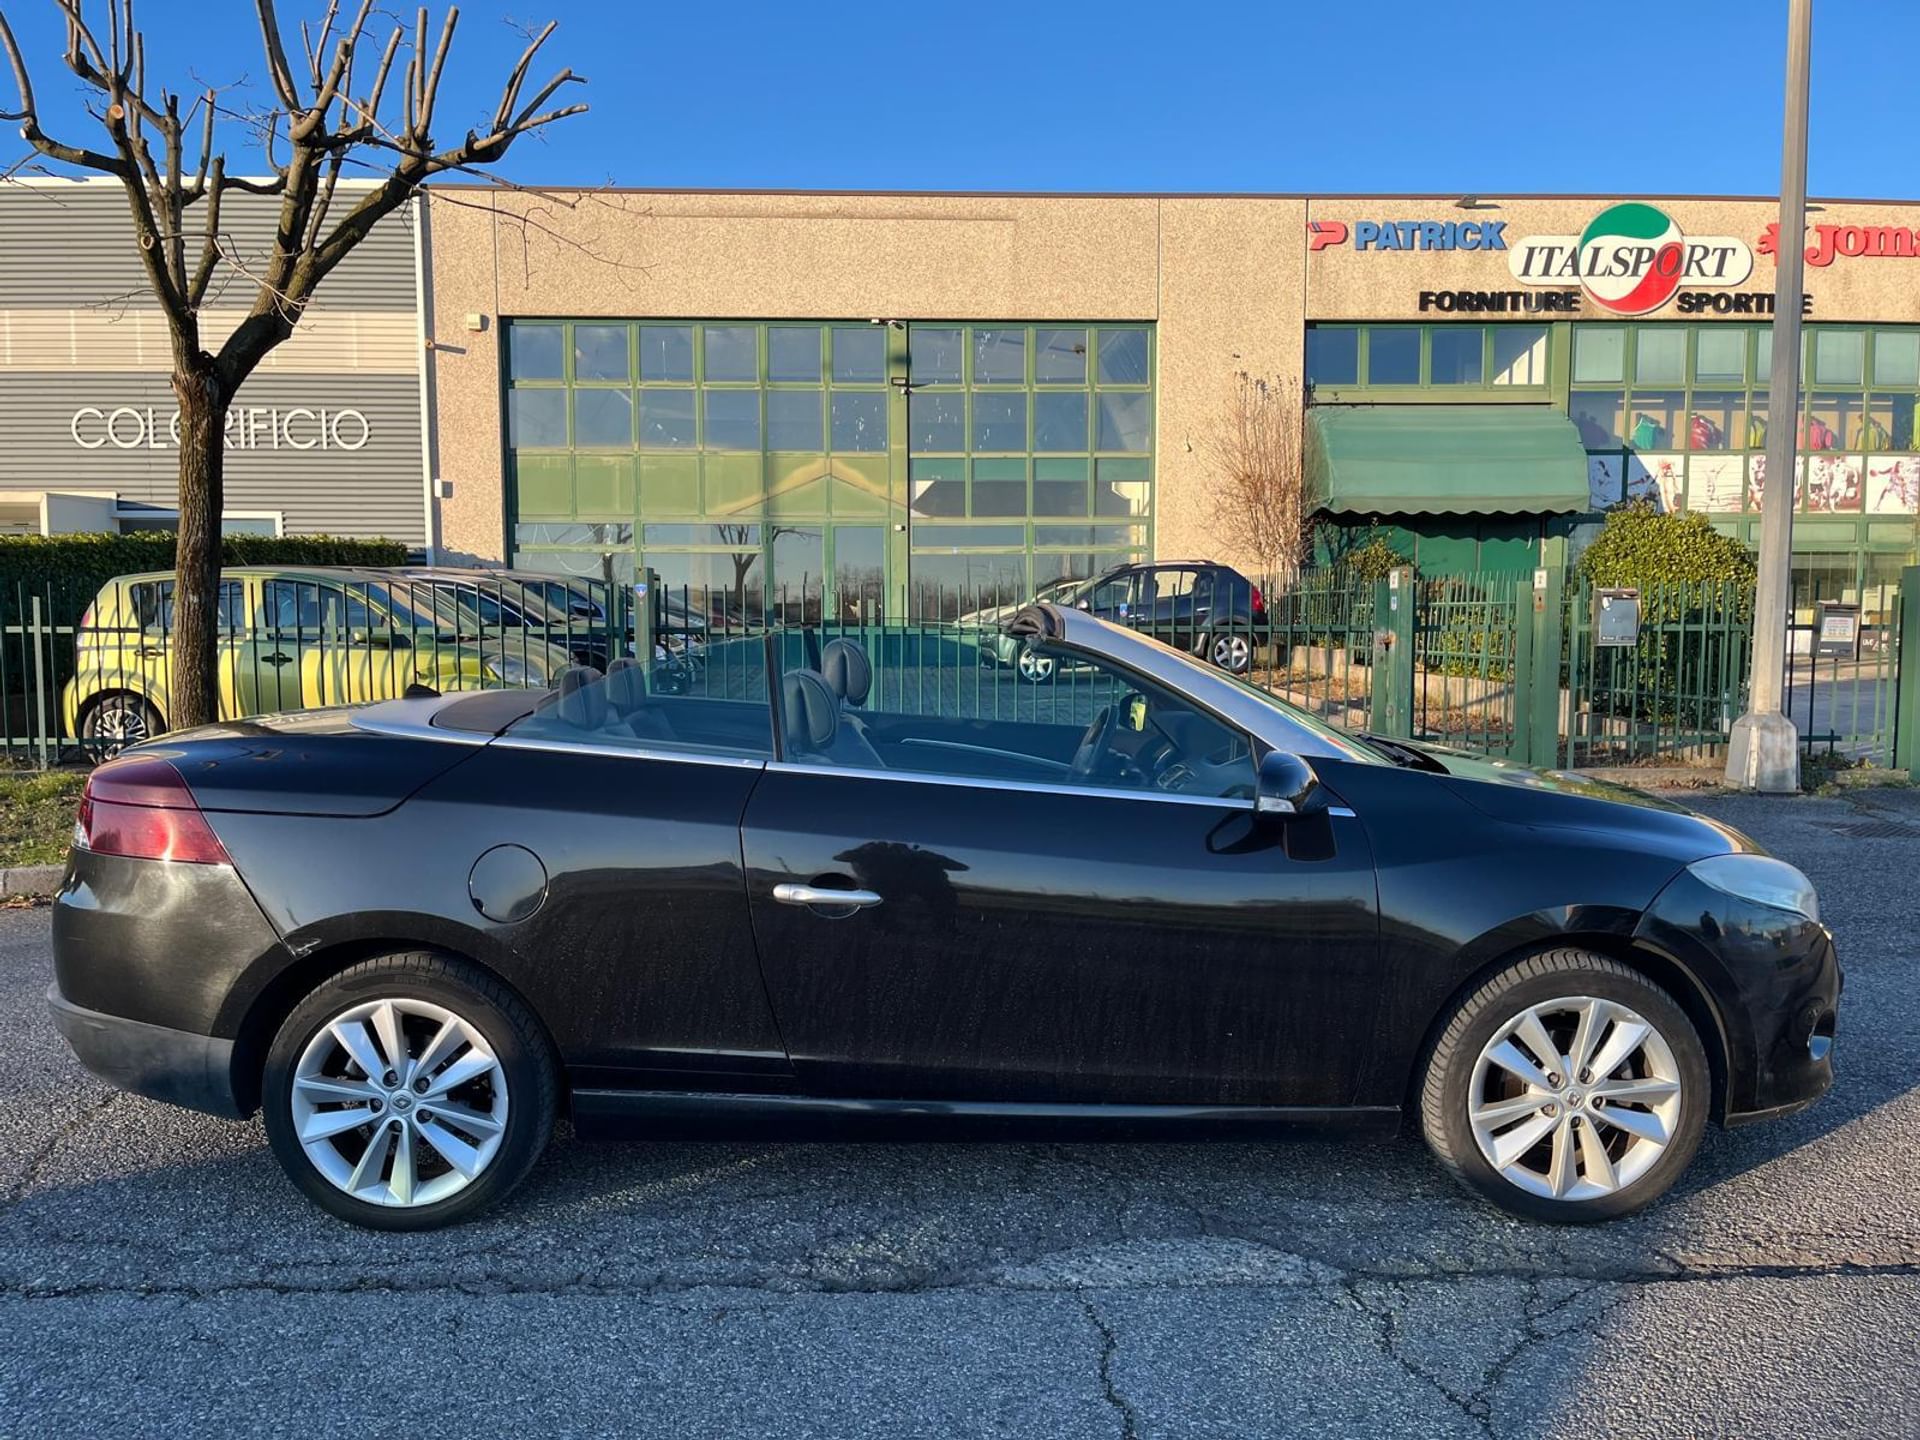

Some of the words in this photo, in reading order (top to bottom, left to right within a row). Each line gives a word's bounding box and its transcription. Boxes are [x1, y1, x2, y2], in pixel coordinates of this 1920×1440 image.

[1355, 221, 1508, 251] PATRICK
[1805, 224, 1920, 268] Jom
[1517, 243, 1737, 279] ITALSPORT
[1419, 290, 1582, 313] FORNITURE
[1677, 291, 1814, 314] SPORTIE
[70, 406, 370, 450] COLRIFICIO
